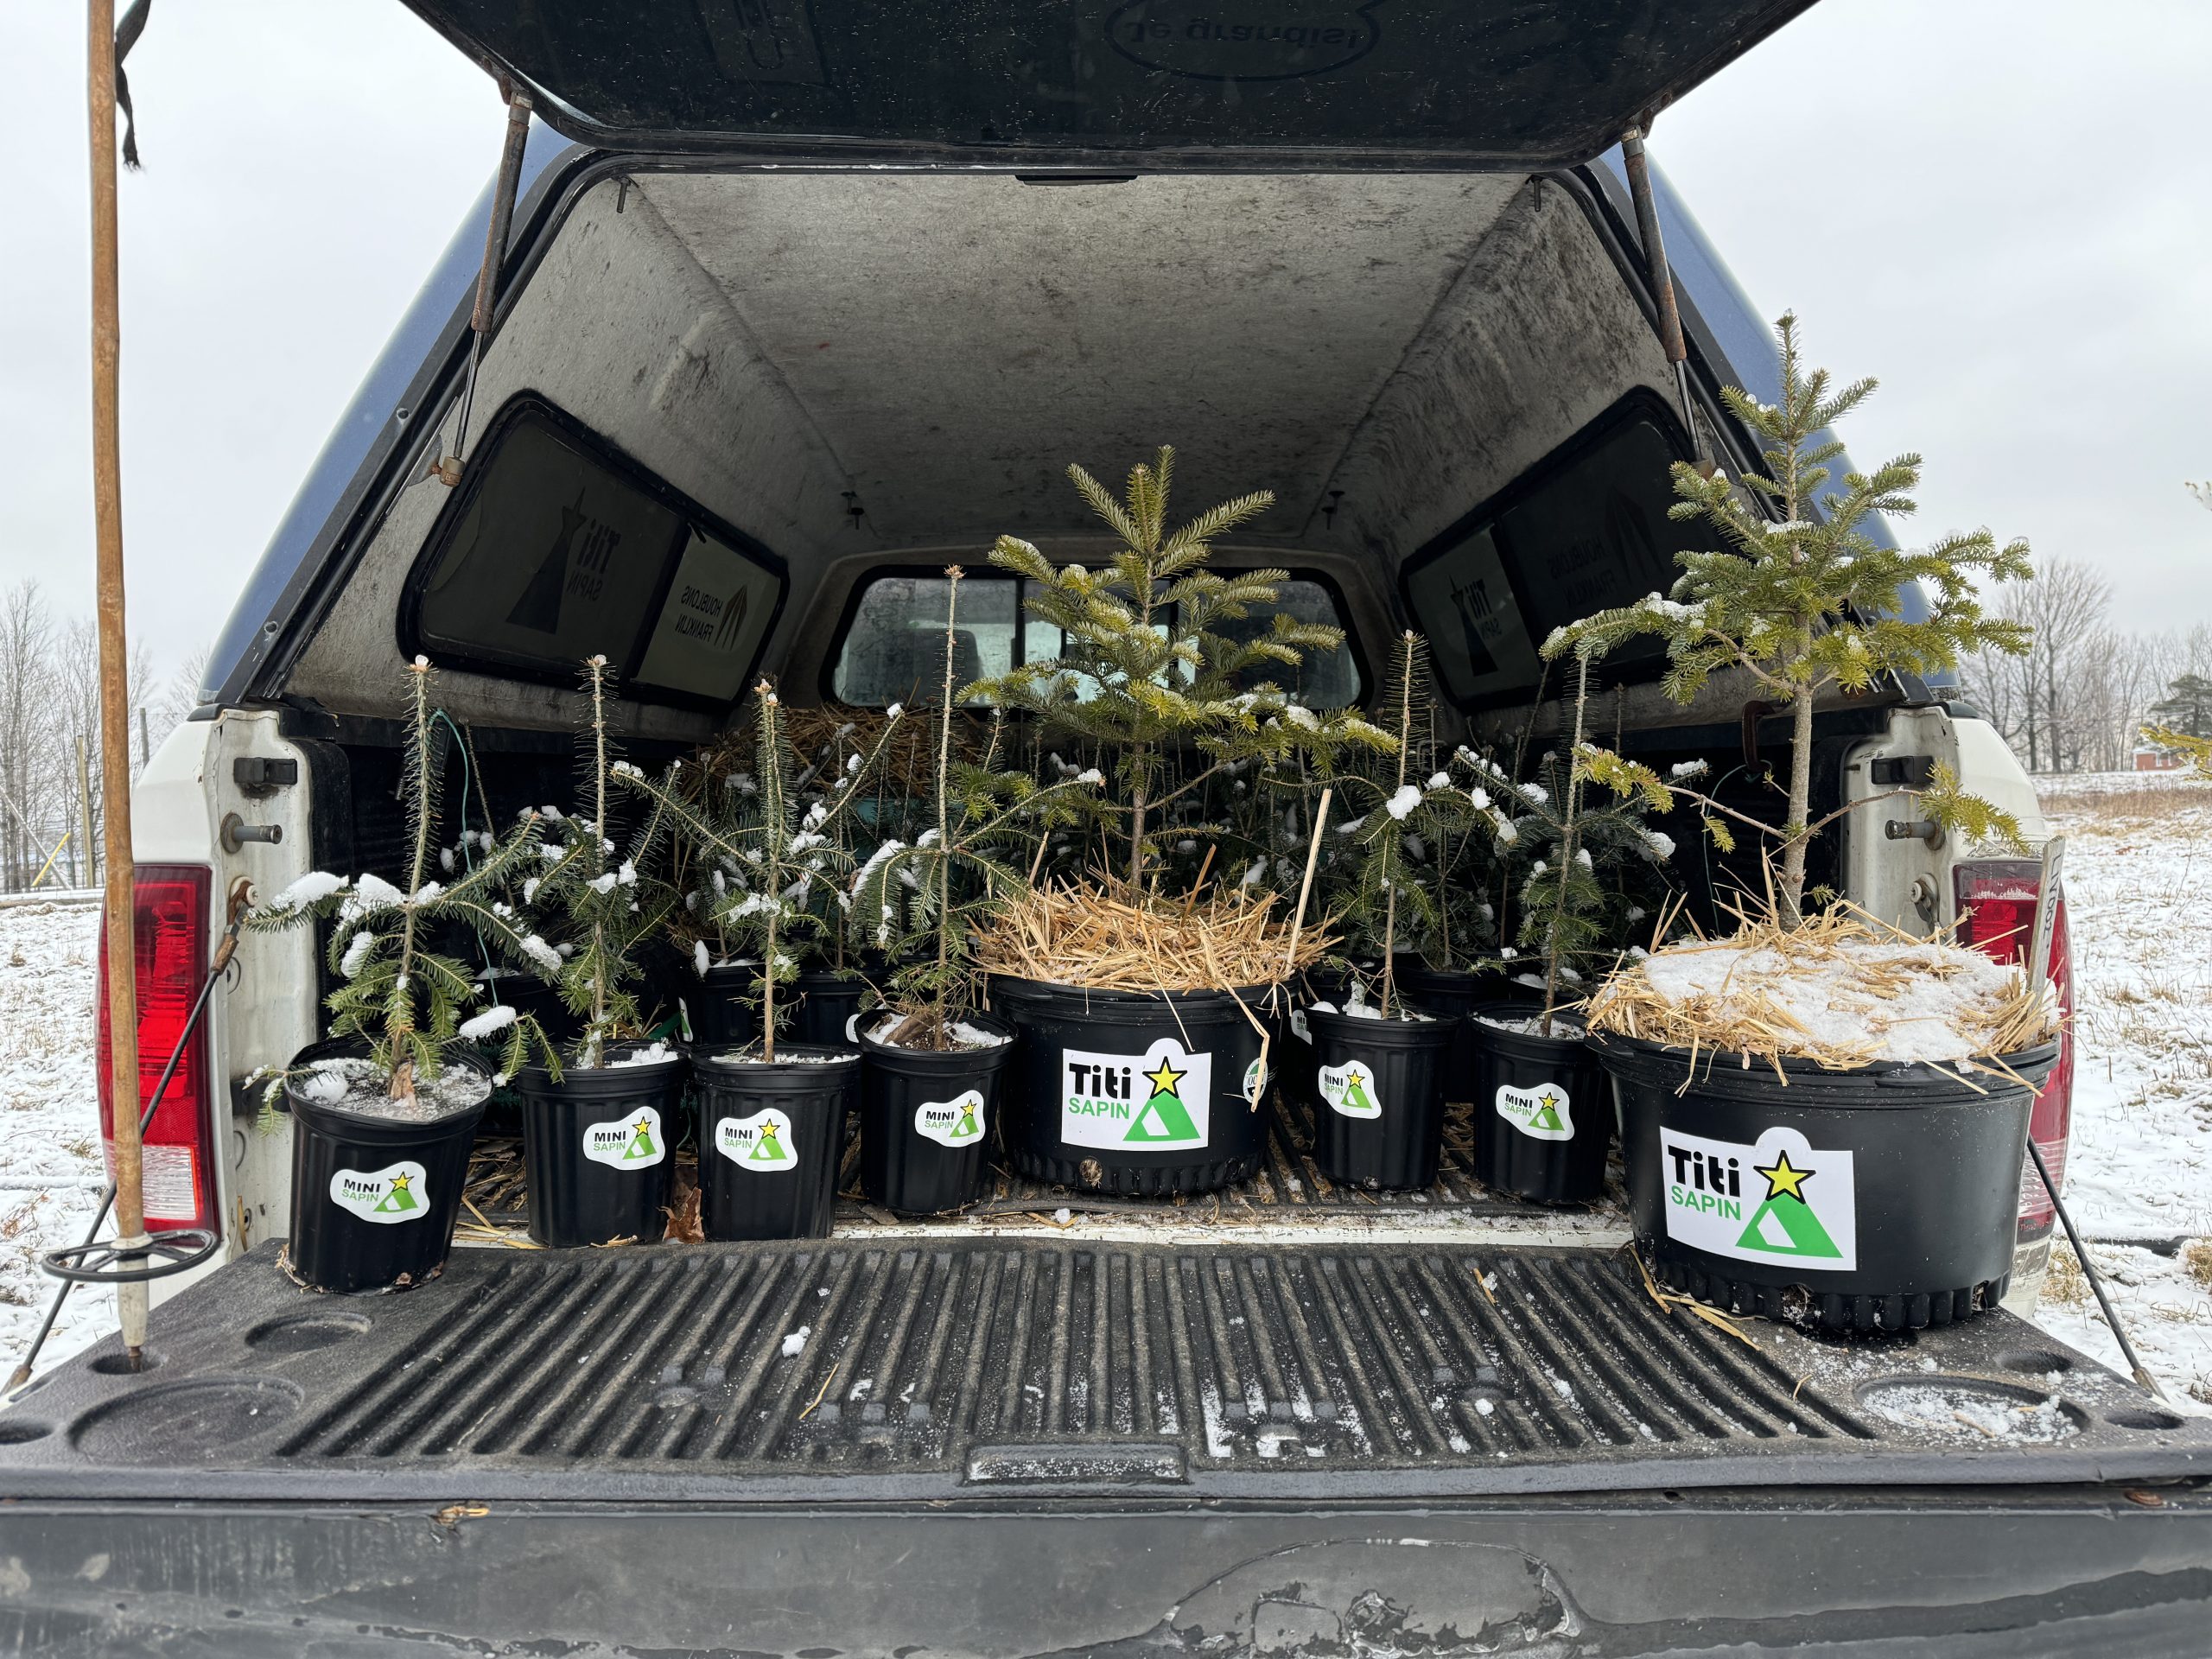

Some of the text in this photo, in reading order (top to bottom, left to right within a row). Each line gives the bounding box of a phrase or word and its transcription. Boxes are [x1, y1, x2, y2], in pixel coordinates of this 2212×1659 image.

[1069, 1063, 1131, 1100] Titi
[1324, 1073, 1344, 1087] MINI
[1324, 1084, 1344, 1095] SAPIN
[1068, 1096, 1130, 1120] SAPIN
[1505, 1093, 1533, 1109] MINI
[925, 1110, 955, 1122] MINI
[1504, 1102, 1533, 1117] SAPIN
[925, 1120, 954, 1129] SAPIN
[594, 1130, 626, 1142] MINI
[725, 1127, 753, 1140] MINI
[593, 1141, 626, 1152] SAPIN
[724, 1136, 753, 1149] SAPIN
[1667, 1145, 1741, 1198] Titi
[343, 1178, 381, 1193] MINI
[341, 1188, 380, 1203] SAPIN
[1670, 1185, 1742, 1221] SAPIN
